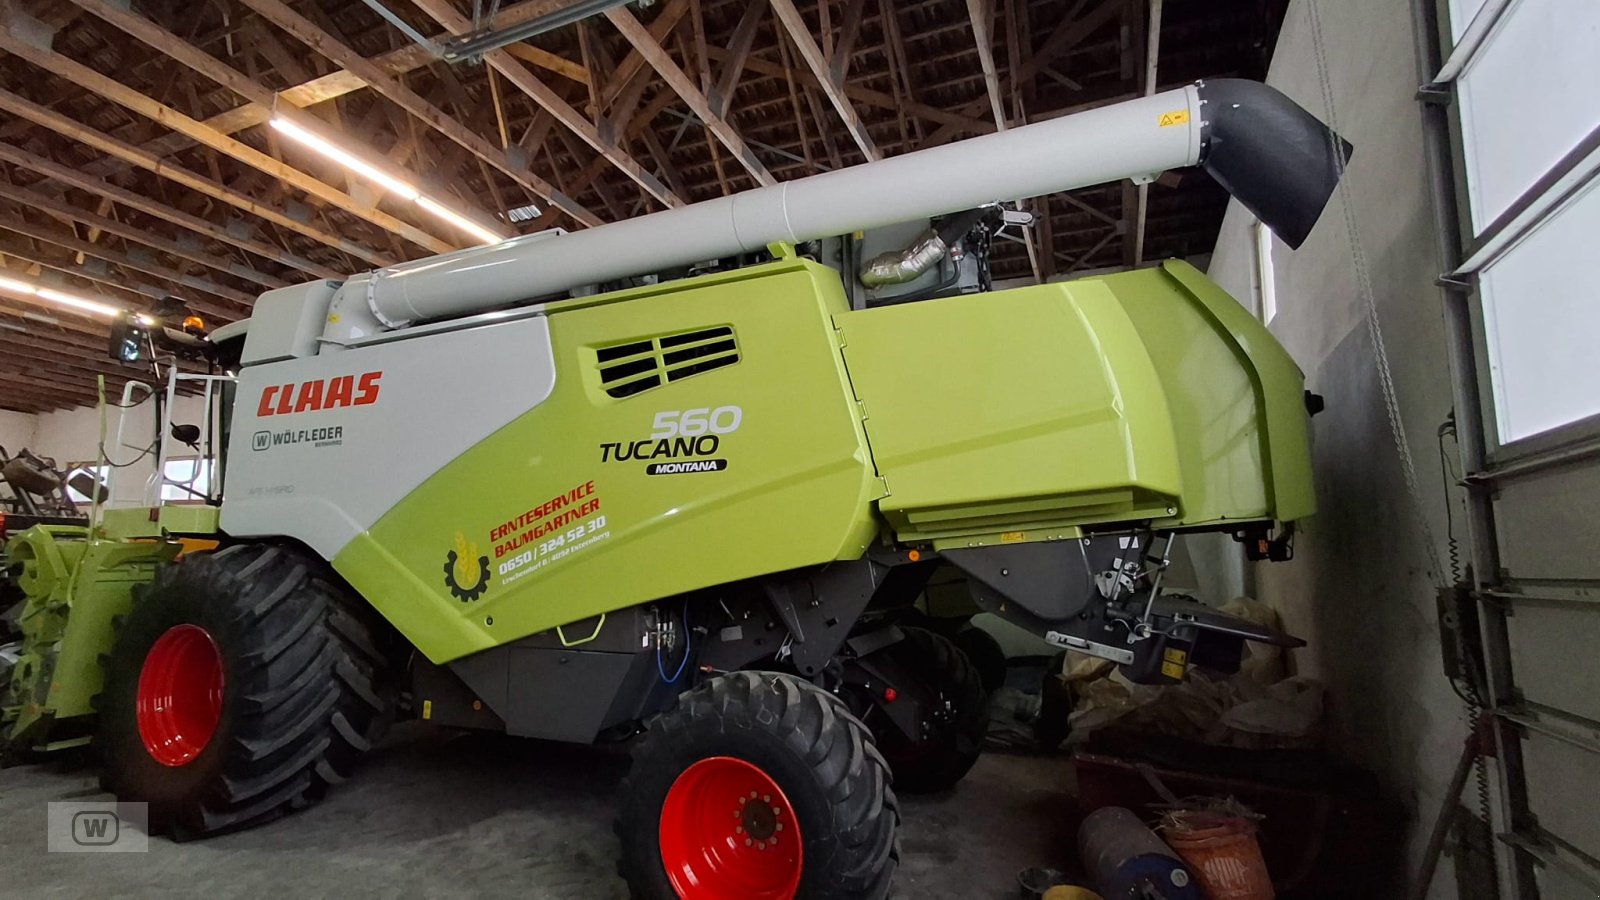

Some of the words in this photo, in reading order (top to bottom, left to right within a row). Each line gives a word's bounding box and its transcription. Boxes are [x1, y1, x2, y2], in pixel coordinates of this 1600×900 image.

[257, 371, 383, 417] CLAAS
[273, 426, 343, 445] WÖLFLEDER
[651, 405, 743, 439] 560
[600, 435, 720, 462] TUCANO
[655, 460, 718, 474] MONTANA
[490, 480, 594, 542] ERNTESERVICE
[495, 498, 600, 558] BAUMGARTNER
[499, 551, 532, 575] 0650
[540, 534, 565, 556] 324
[567, 525, 585, 543] 52
[587, 515, 606, 533] 30
